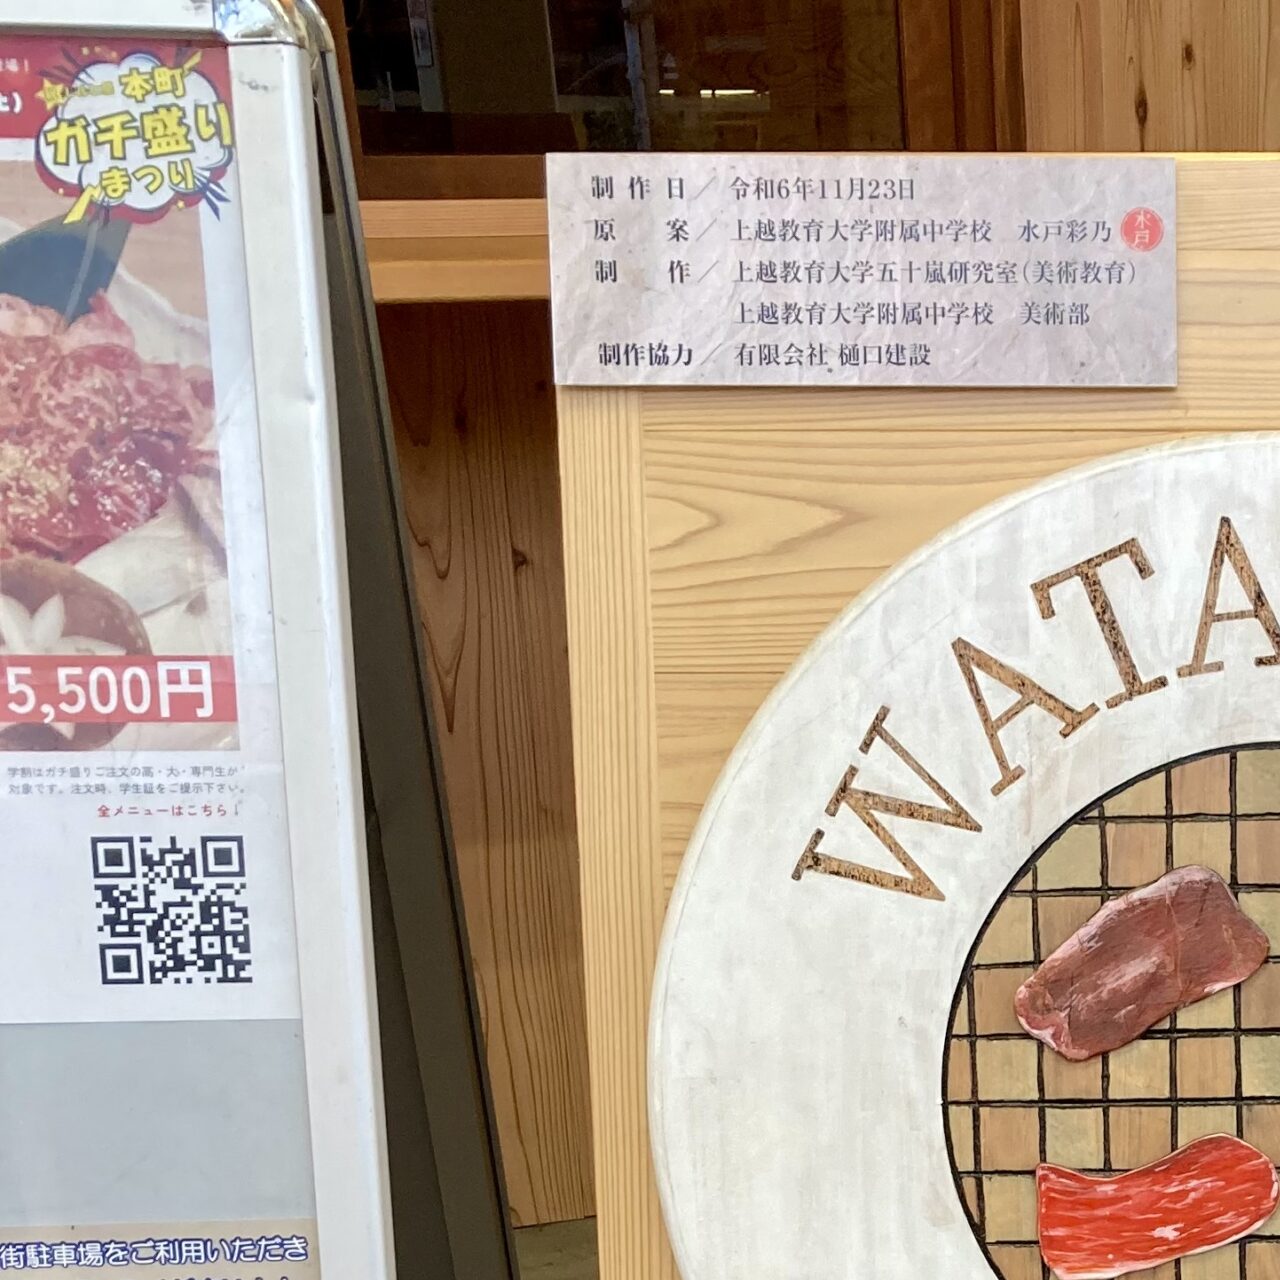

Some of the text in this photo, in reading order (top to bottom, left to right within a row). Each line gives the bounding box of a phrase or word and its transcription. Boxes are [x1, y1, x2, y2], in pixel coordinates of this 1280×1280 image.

[119, 66, 187, 102] 本町
[45, 103, 234, 166] ガチ盛り
[101, 159, 196, 199] まつり
[731, 176, 915, 200] 令和6年11月23日
[731, 218, 992, 242] 上越教育大学附属中学校
[1018, 219, 1112, 242] 水戸彩乃
[734, 301, 1090, 326] 上越教育大学附属中学校 美術部
[734, 342, 828, 366] 有限会社
[838, 342, 931, 366] 樋口建設
[6, 660, 215, 723] 5,500円
[0, 1234, 309, 1270] 街駐車場をご利用いただき
